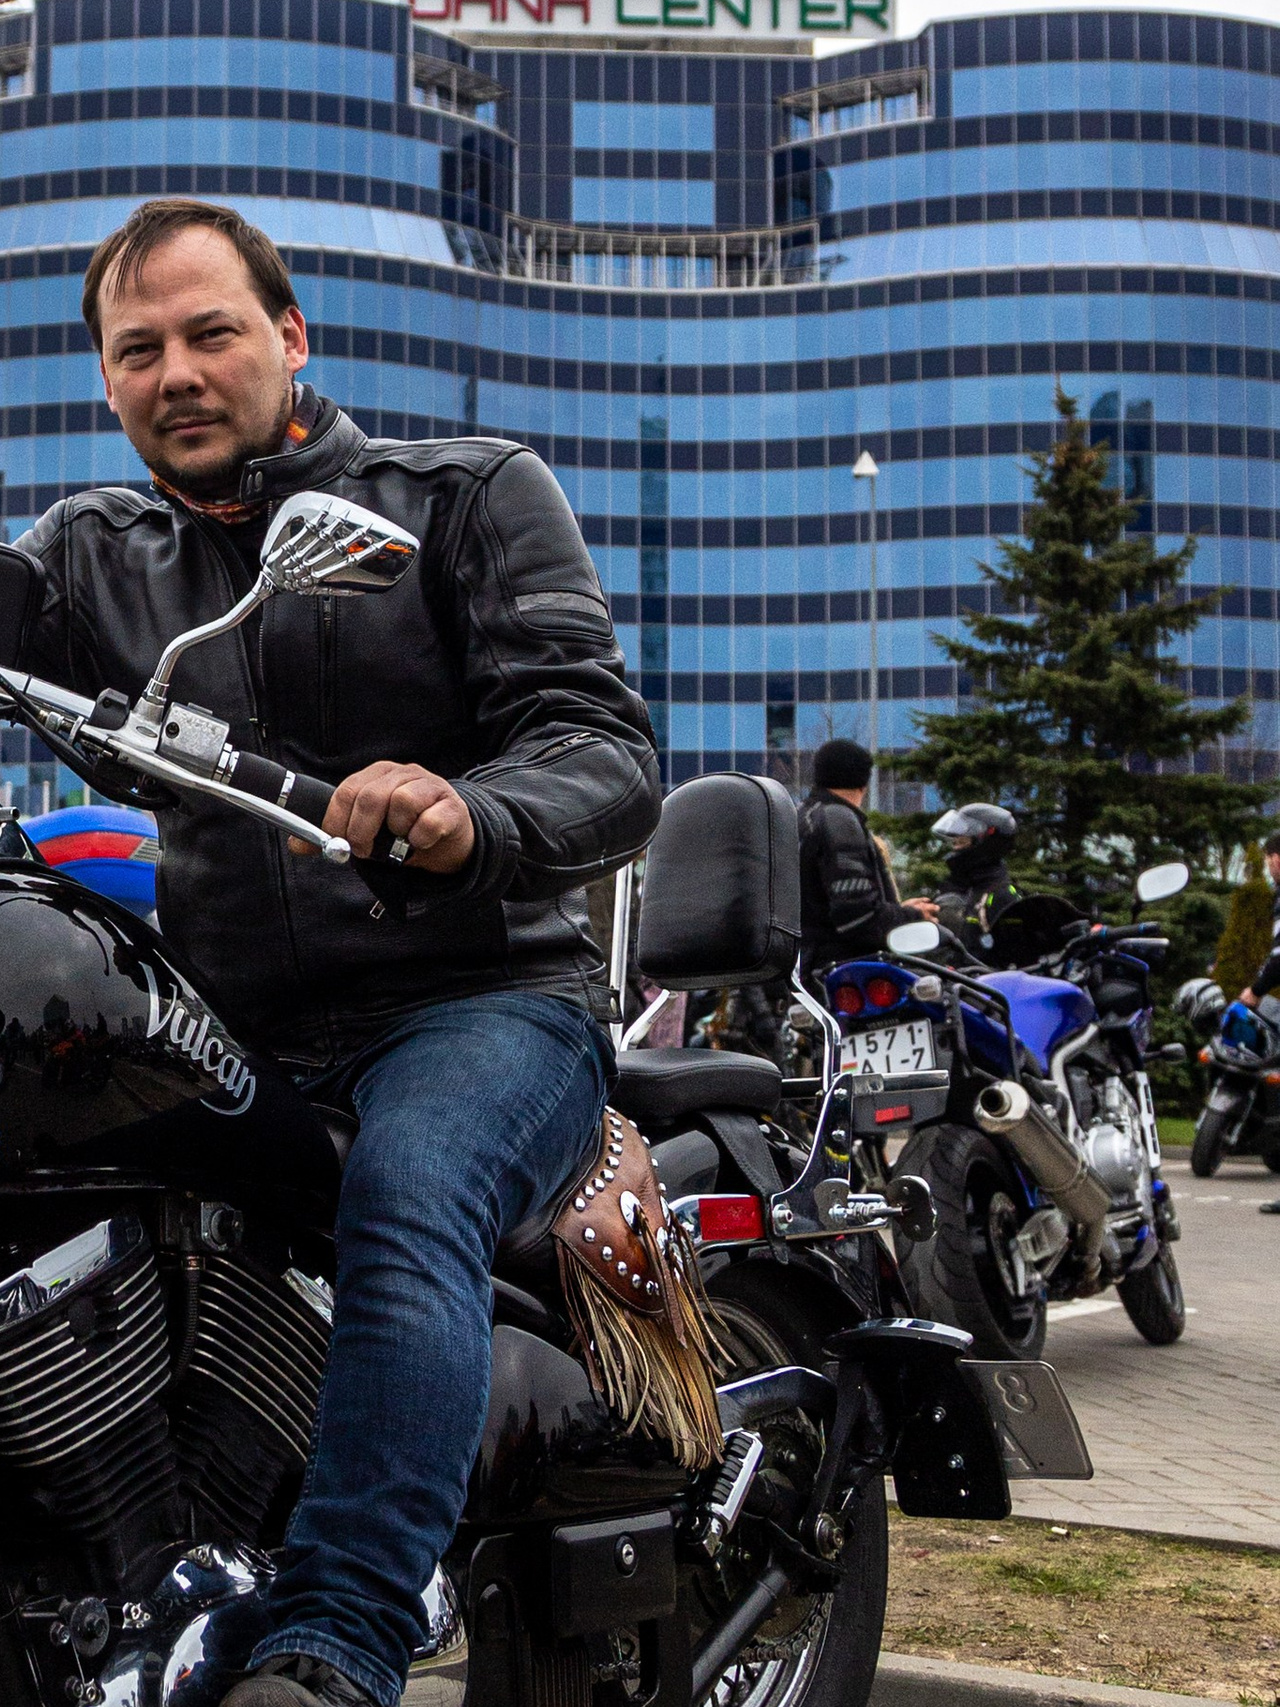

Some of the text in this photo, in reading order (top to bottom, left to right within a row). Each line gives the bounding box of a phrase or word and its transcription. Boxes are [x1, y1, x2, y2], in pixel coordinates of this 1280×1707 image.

[616, 0, 889, 30] CENTER
[138, 961, 256, 1116] Vulcan
[848, 1024, 917, 1058] 1571
